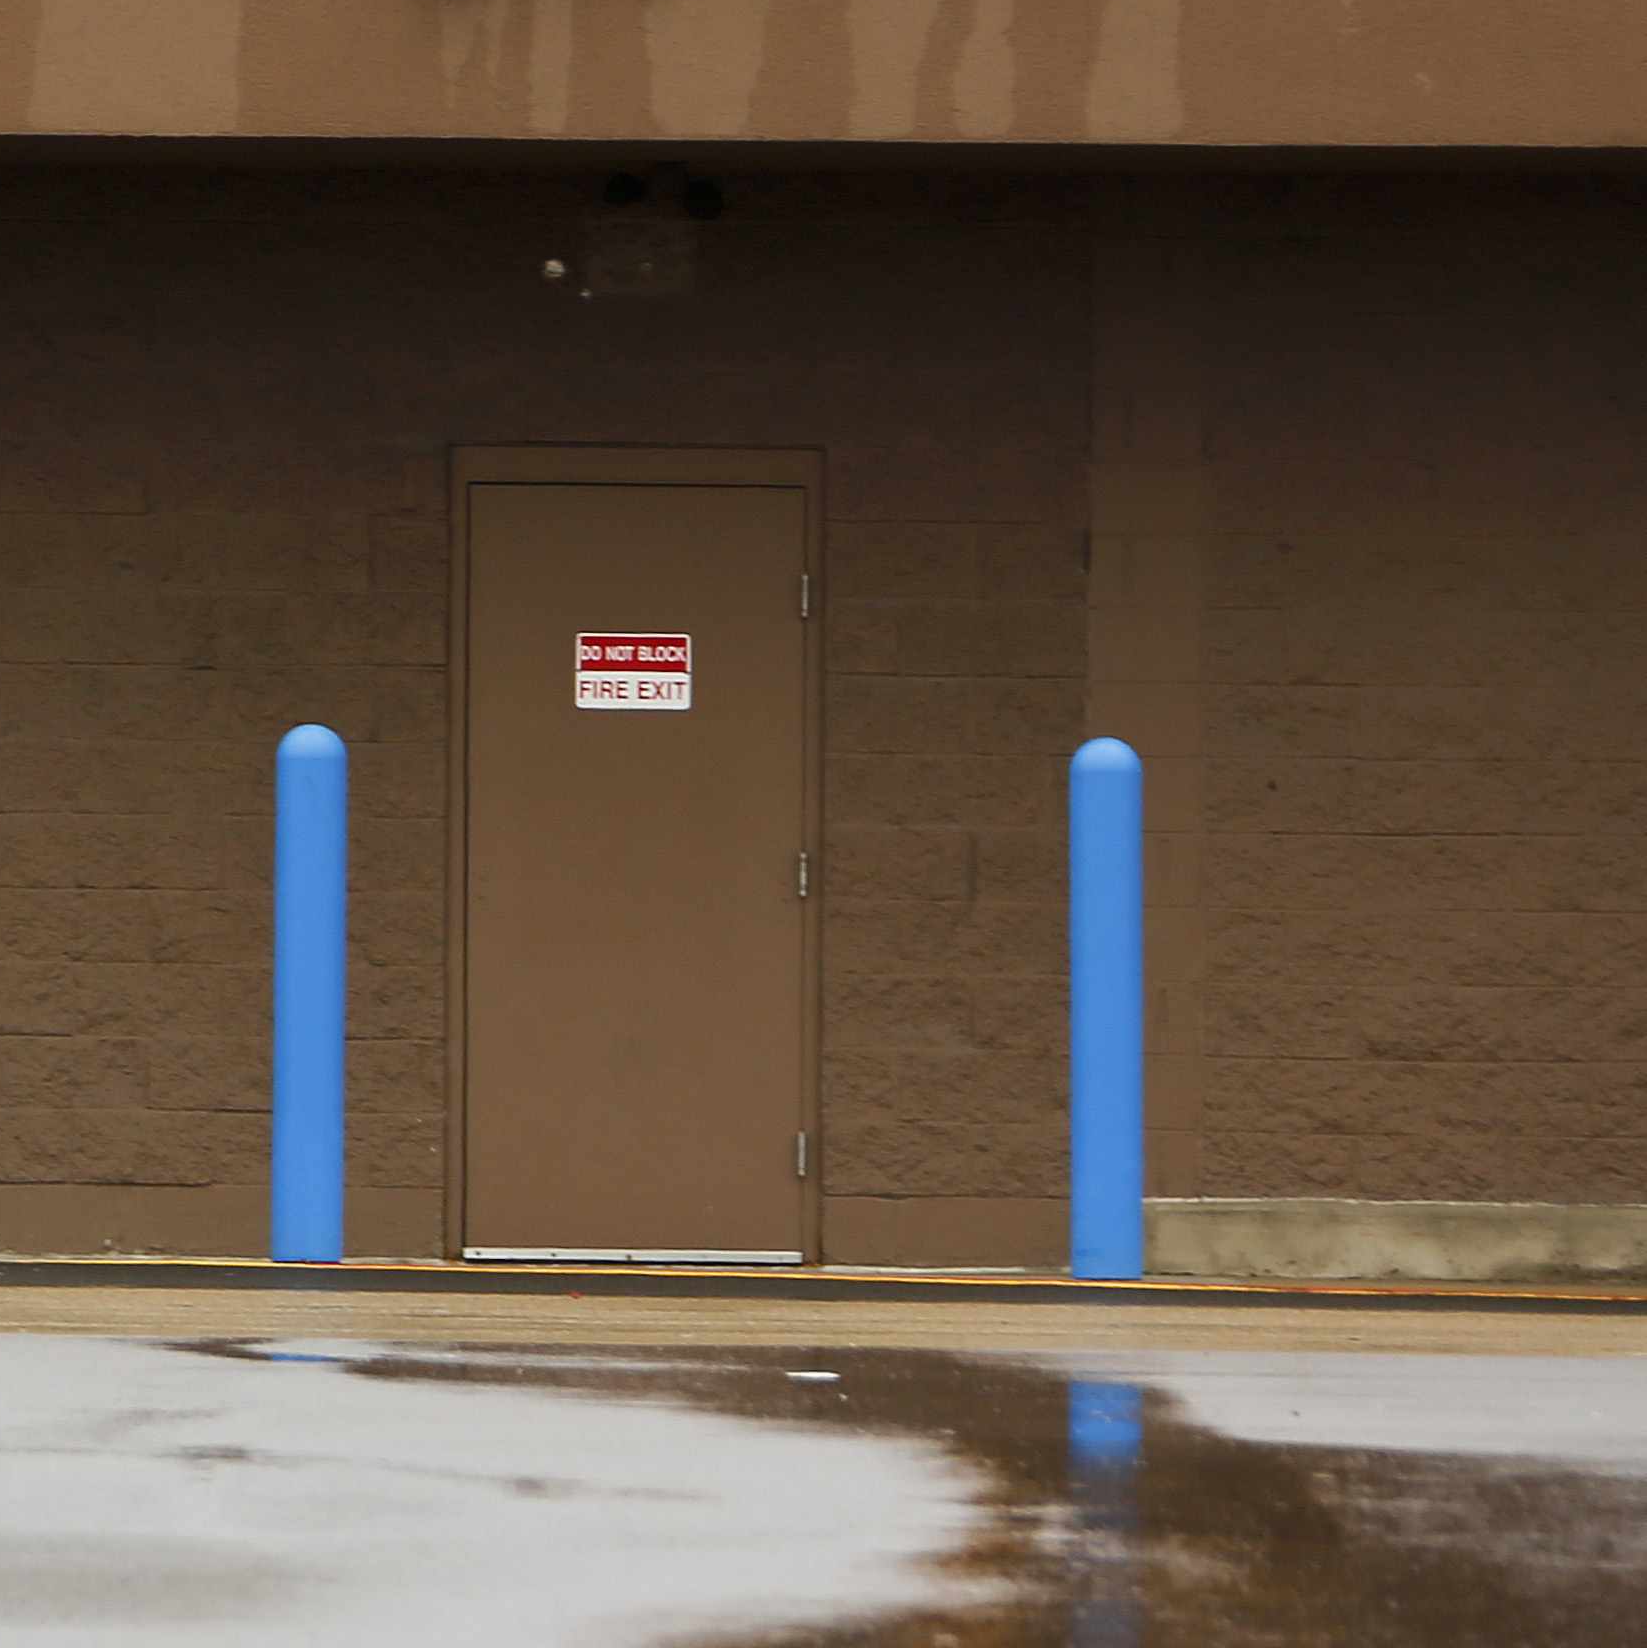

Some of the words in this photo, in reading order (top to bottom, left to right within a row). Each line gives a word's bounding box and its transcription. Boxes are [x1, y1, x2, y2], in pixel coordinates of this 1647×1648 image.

[581, 645, 602, 661] DO
[605, 645, 635, 661] NOT
[637, 646, 687, 662] BLOCK
[580, 680, 629, 699] FIRE
[638, 680, 687, 700] EXIT
